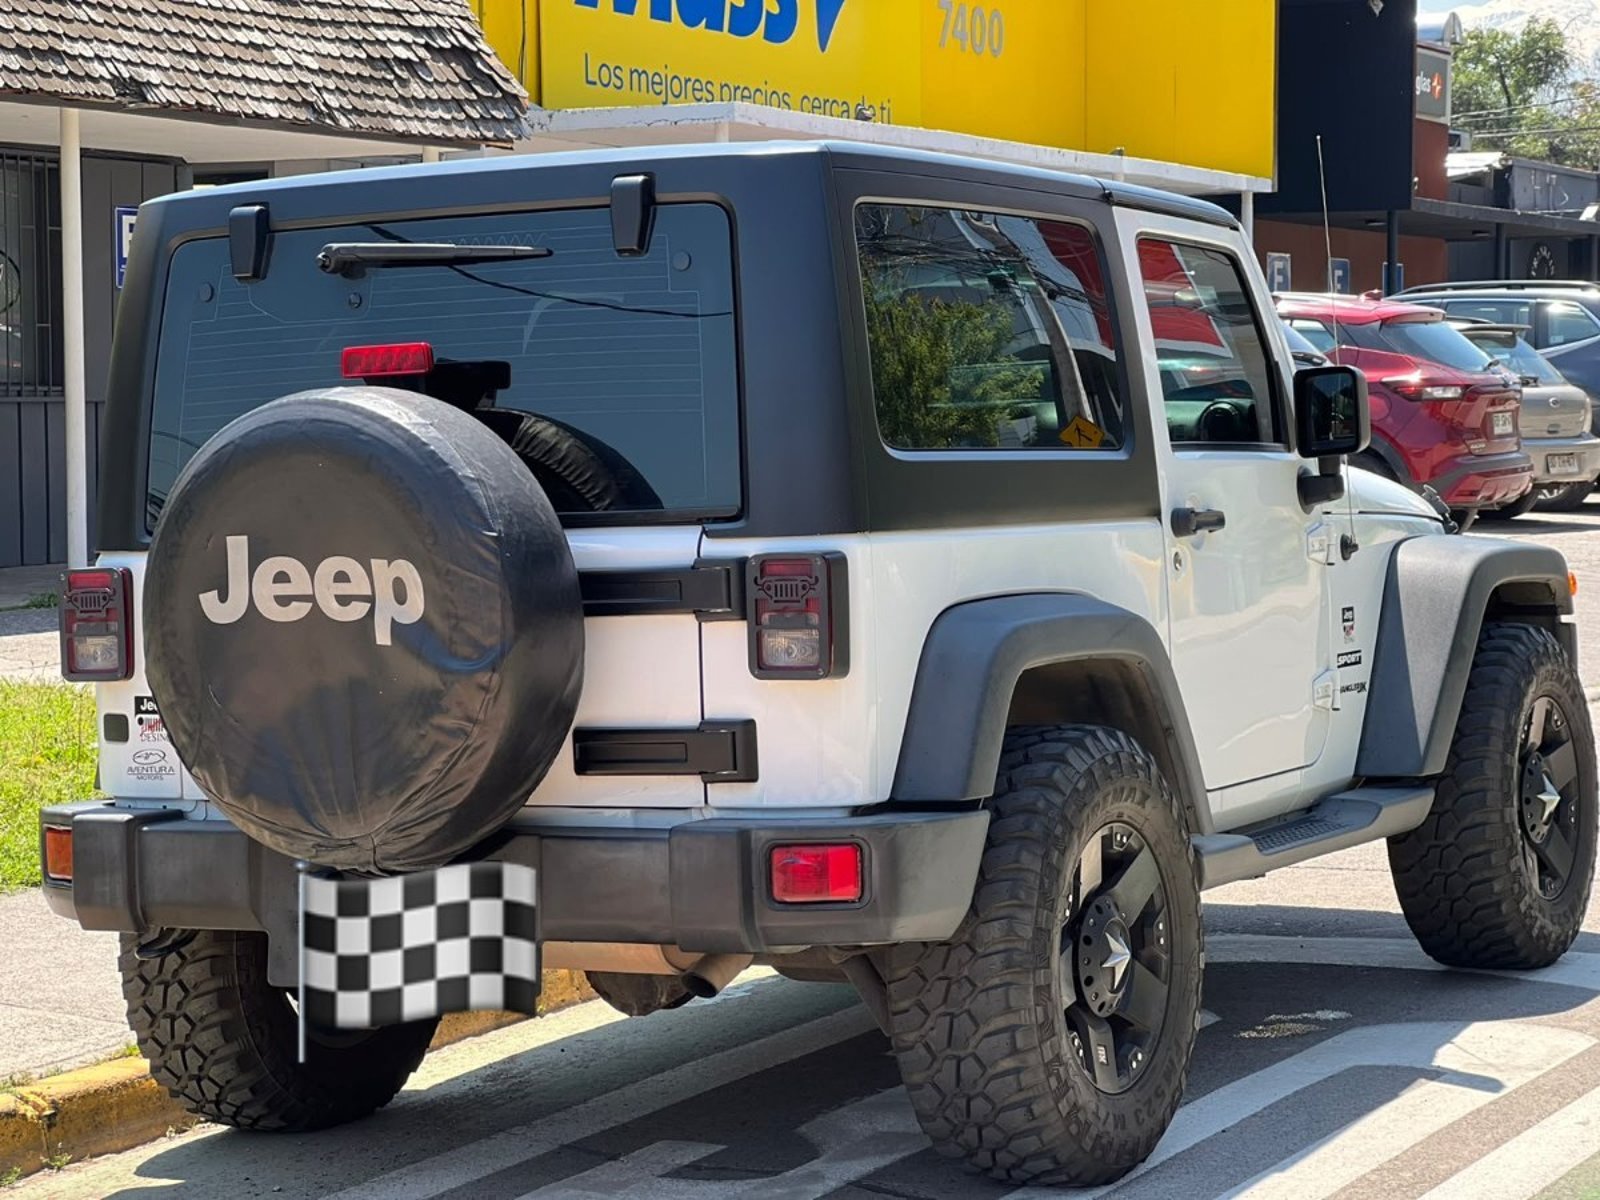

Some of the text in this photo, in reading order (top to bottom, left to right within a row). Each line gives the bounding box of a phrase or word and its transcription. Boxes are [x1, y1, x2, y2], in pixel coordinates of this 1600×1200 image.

[937, 0, 1004, 58] 7400
[584, 52, 624, 90] Los
[629, 64, 714, 105] mejores
[800, 94, 850, 119] cerca
[880, 98, 891, 124] ti
[199, 535, 425, 646] Jeep
[1337, 653, 1361, 665] SPORT
[127, 766, 175, 774] AVENTURA
